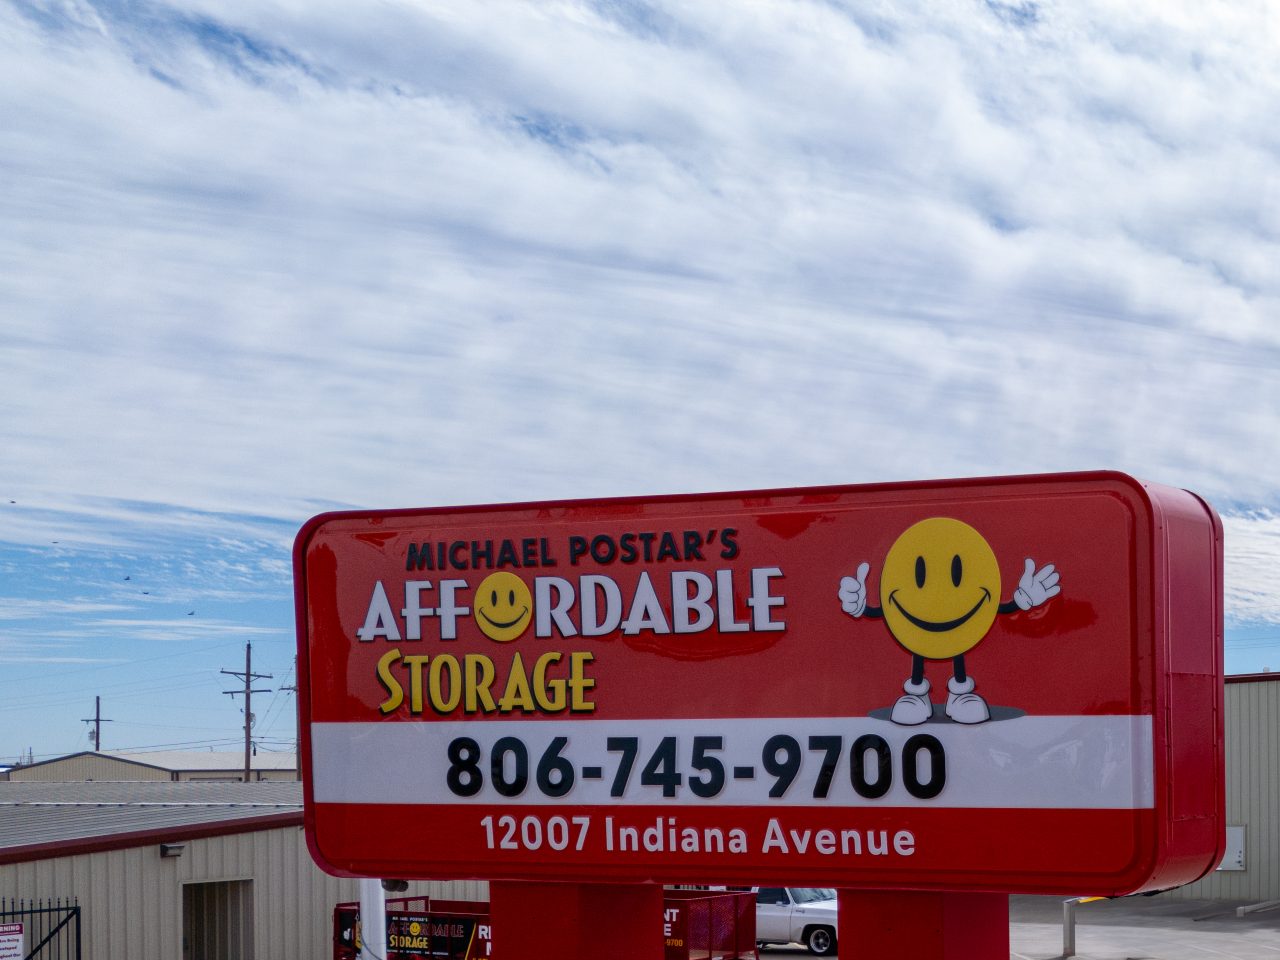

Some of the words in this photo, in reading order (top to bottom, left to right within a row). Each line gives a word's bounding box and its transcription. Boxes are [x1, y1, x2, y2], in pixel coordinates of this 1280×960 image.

[405, 537, 556, 571] MICHAEL
[568, 527, 739, 565] POSTAR'S
[357, 566, 786, 642] AFFORDABLE
[376, 648, 596, 715] STORAGE
[445, 733, 947, 801] 806-745-9700
[480, 815, 591, 851] 12007
[605, 817, 748, 854] Indiana
[760, 818, 916, 857] Avenue
[389, 934, 429, 949] STORAGE
